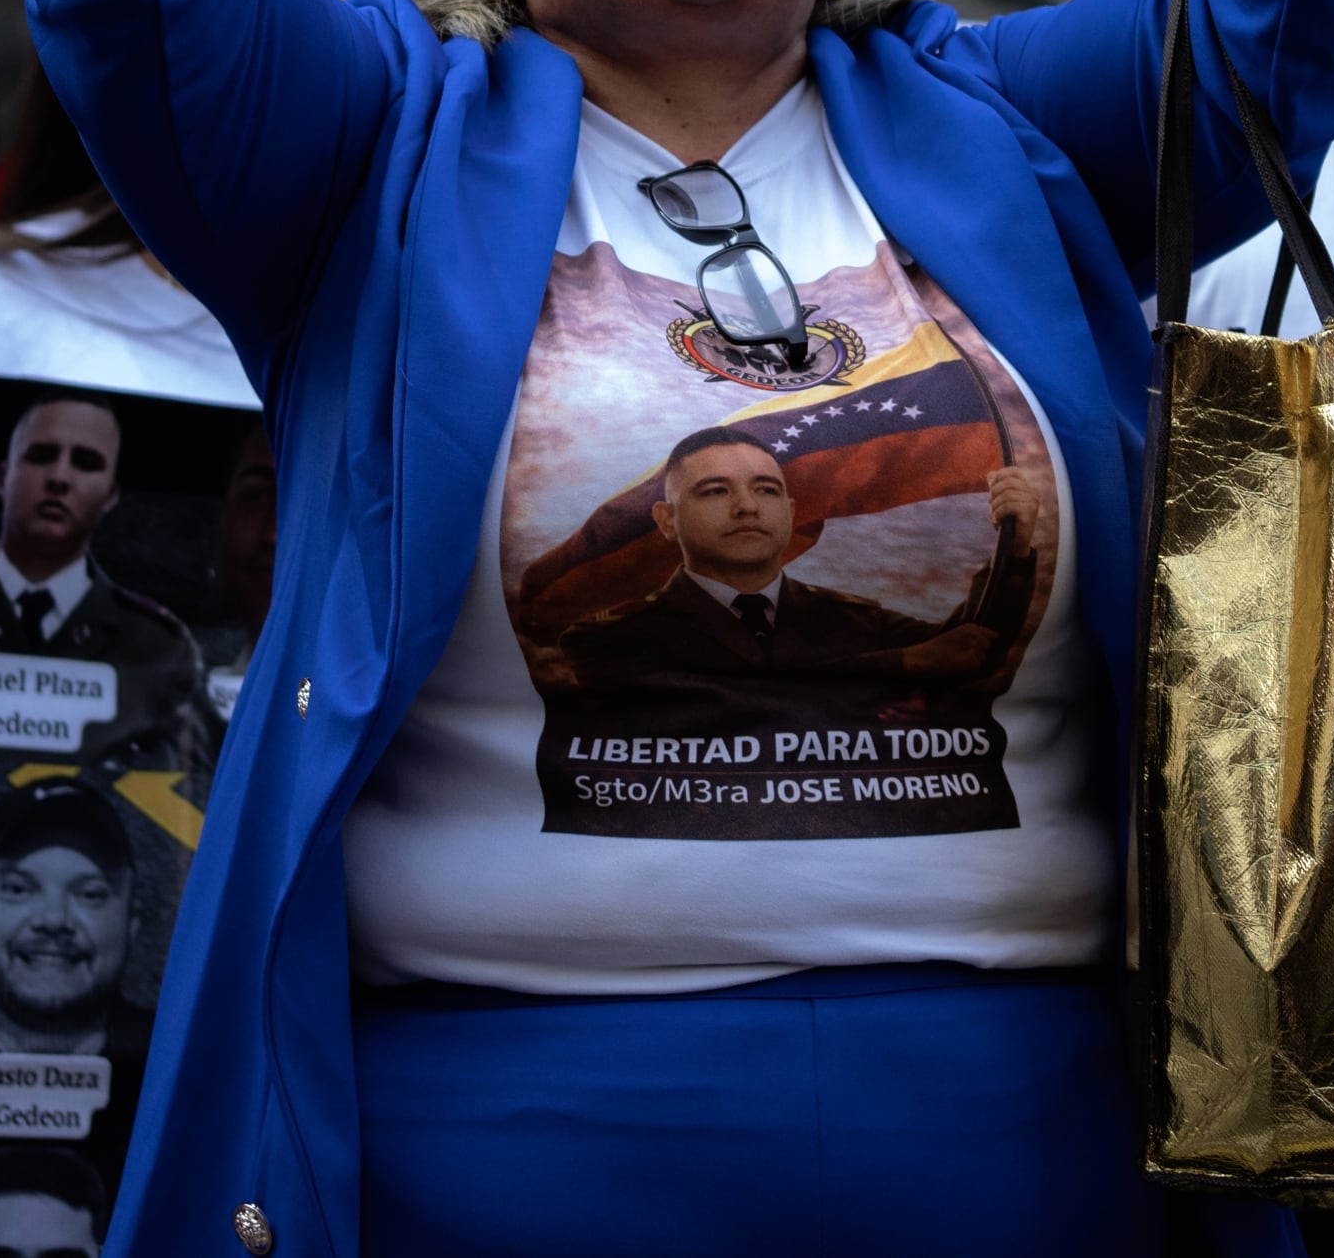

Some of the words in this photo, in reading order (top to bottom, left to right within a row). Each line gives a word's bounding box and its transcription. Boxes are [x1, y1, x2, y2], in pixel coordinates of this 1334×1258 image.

[724, 366, 821, 387] GEDEON
[34, 671, 104, 701] Plaza
[567, 735, 761, 764] LIBERTAD
[774, 729, 879, 763] PARA
[883, 727, 991, 760] TODOS
[573, 774, 750, 807] Sgto/M3ra
[759, 777, 844, 805] JOSE
[851, 771, 989, 803] MORENO.
[42, 1066, 100, 1091] Daza
